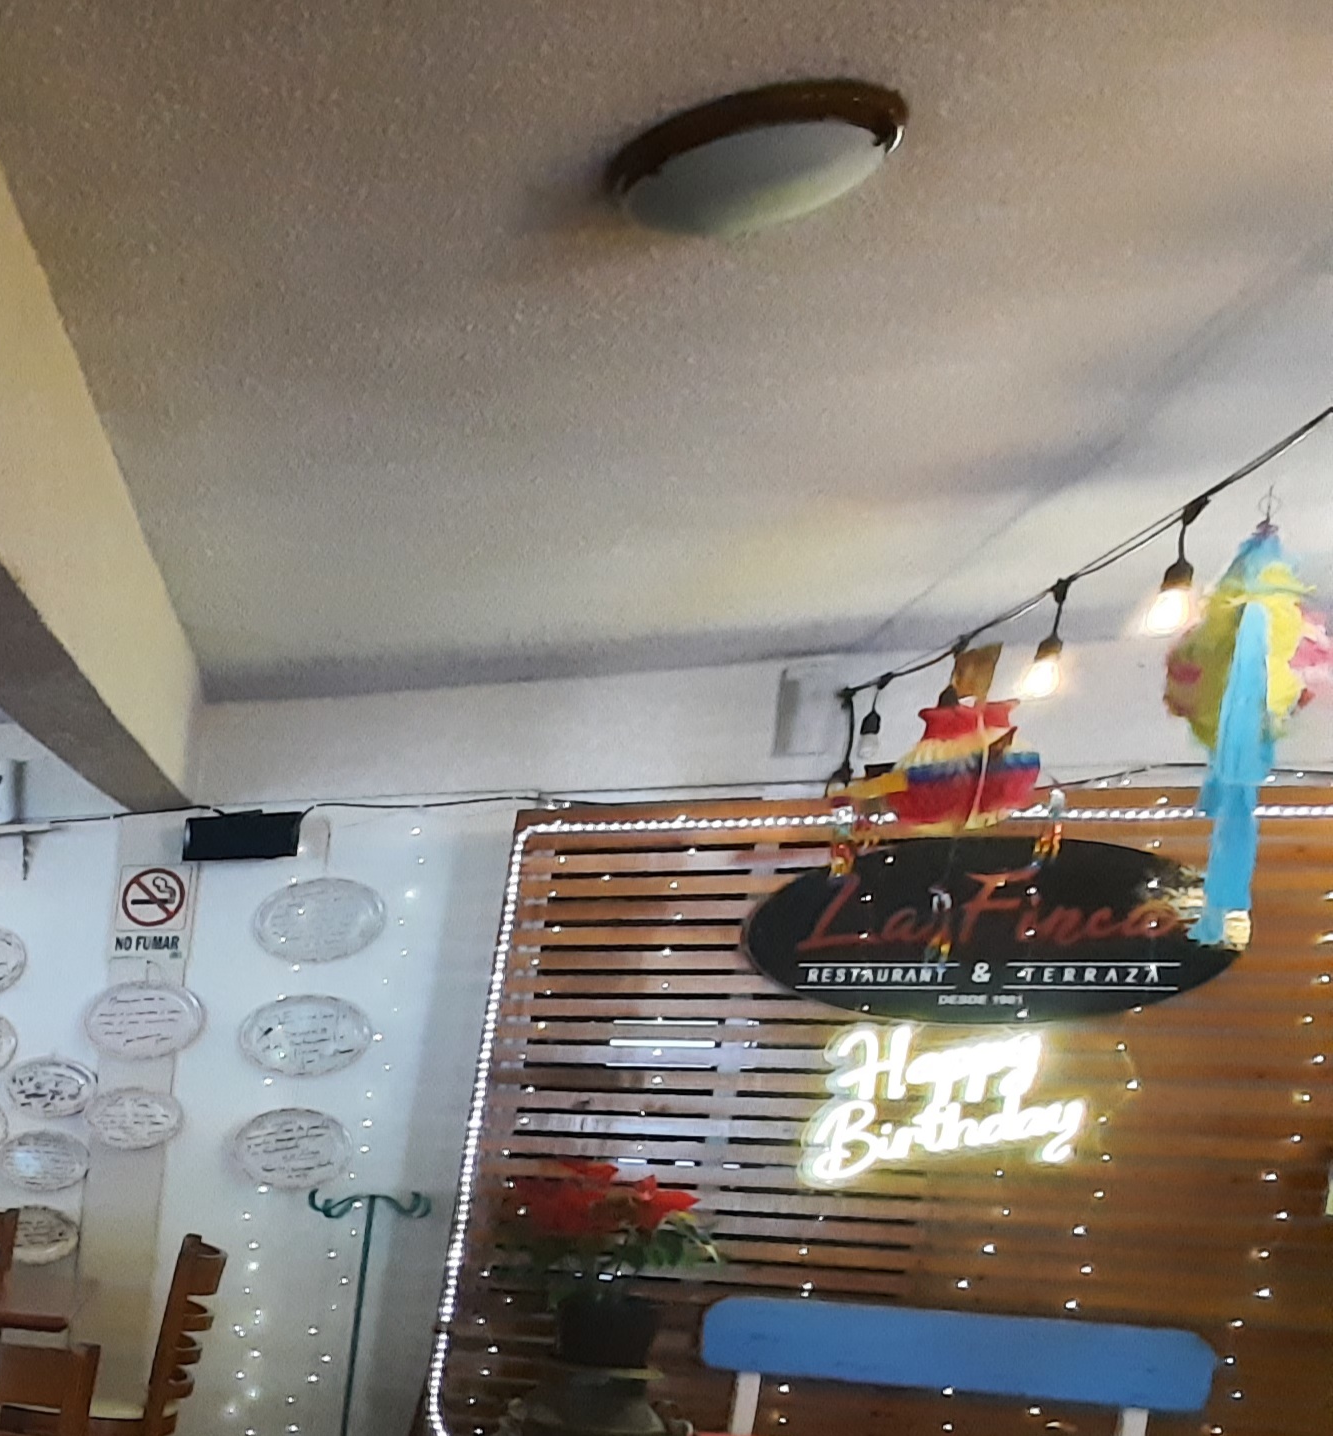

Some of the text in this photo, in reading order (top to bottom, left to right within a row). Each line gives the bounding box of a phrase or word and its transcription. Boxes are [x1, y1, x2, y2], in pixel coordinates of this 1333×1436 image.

[114, 935, 180, 951] NO FUMAR
[797, 868, 1181, 950] La Finca
[806, 962, 1160, 983] RESTAURANT & TERRAZA
[836, 1024, 1042, 1102] Happy
[812, 1098, 1085, 1180] Birthday
